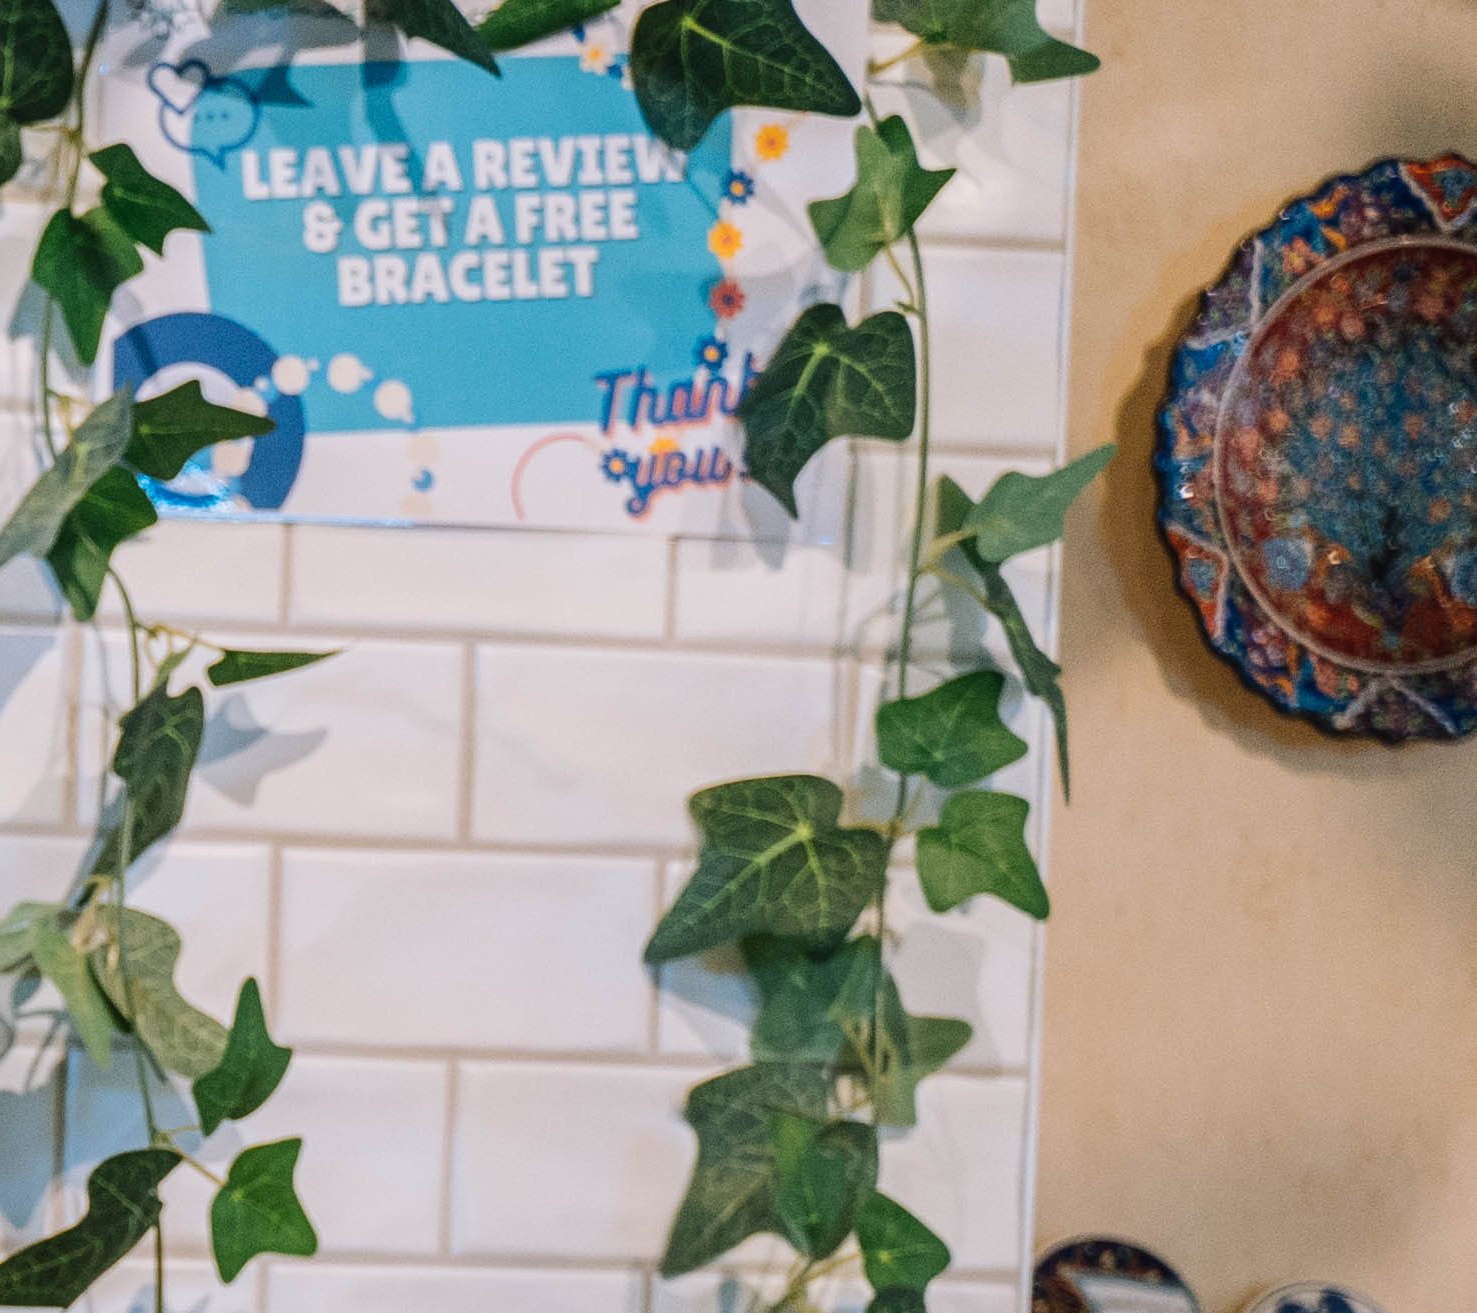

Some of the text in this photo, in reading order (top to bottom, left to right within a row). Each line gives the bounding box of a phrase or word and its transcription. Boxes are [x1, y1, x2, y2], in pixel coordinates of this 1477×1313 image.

[240, 133, 688, 200] LEAVE A REVIEW
[302, 188, 639, 254] & GET A FREE
[336, 245, 600, 307] BRACELET
